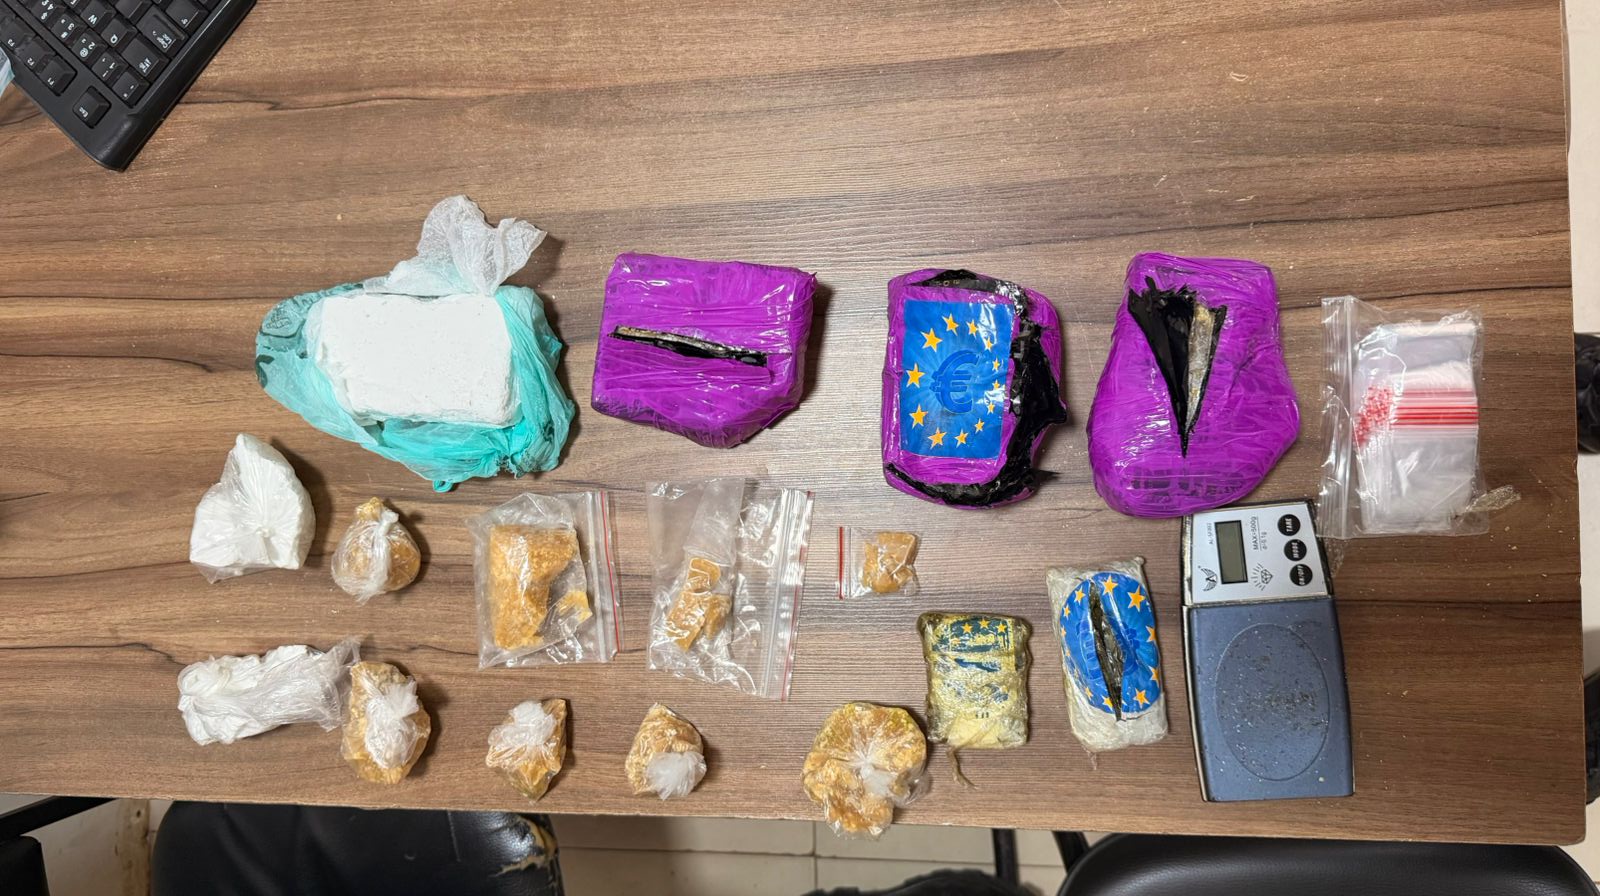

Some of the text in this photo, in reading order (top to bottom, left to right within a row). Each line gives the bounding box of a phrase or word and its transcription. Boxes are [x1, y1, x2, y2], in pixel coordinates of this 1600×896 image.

[88, 14, 98, 25] W
[110, 34, 118, 44] Q
[88, 41, 96, 49] 2
[79, 106, 89, 118] Esc
